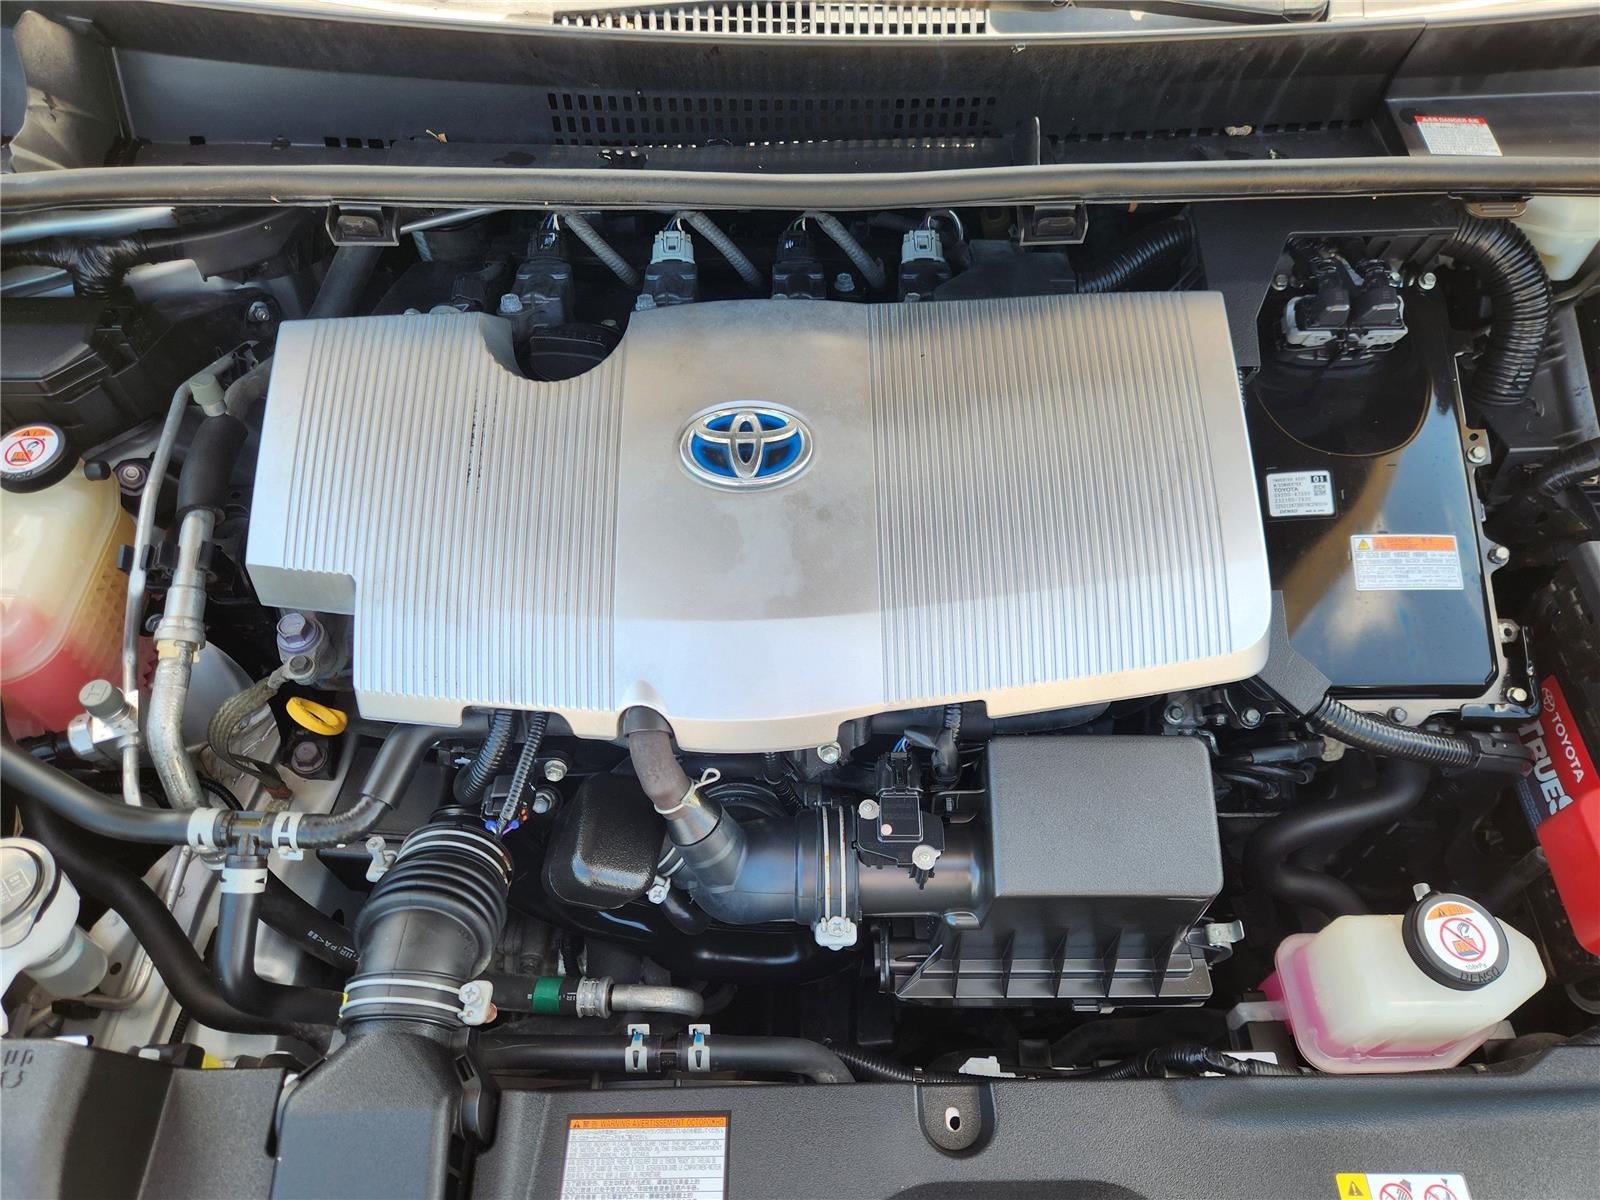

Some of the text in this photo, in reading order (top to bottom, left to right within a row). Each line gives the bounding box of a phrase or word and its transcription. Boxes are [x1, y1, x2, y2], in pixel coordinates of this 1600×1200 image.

[1313, 475, 1324, 483] 01
[1551, 711, 1585, 784] TOYOTA
[1460, 966, 1500, 984] DENSO
